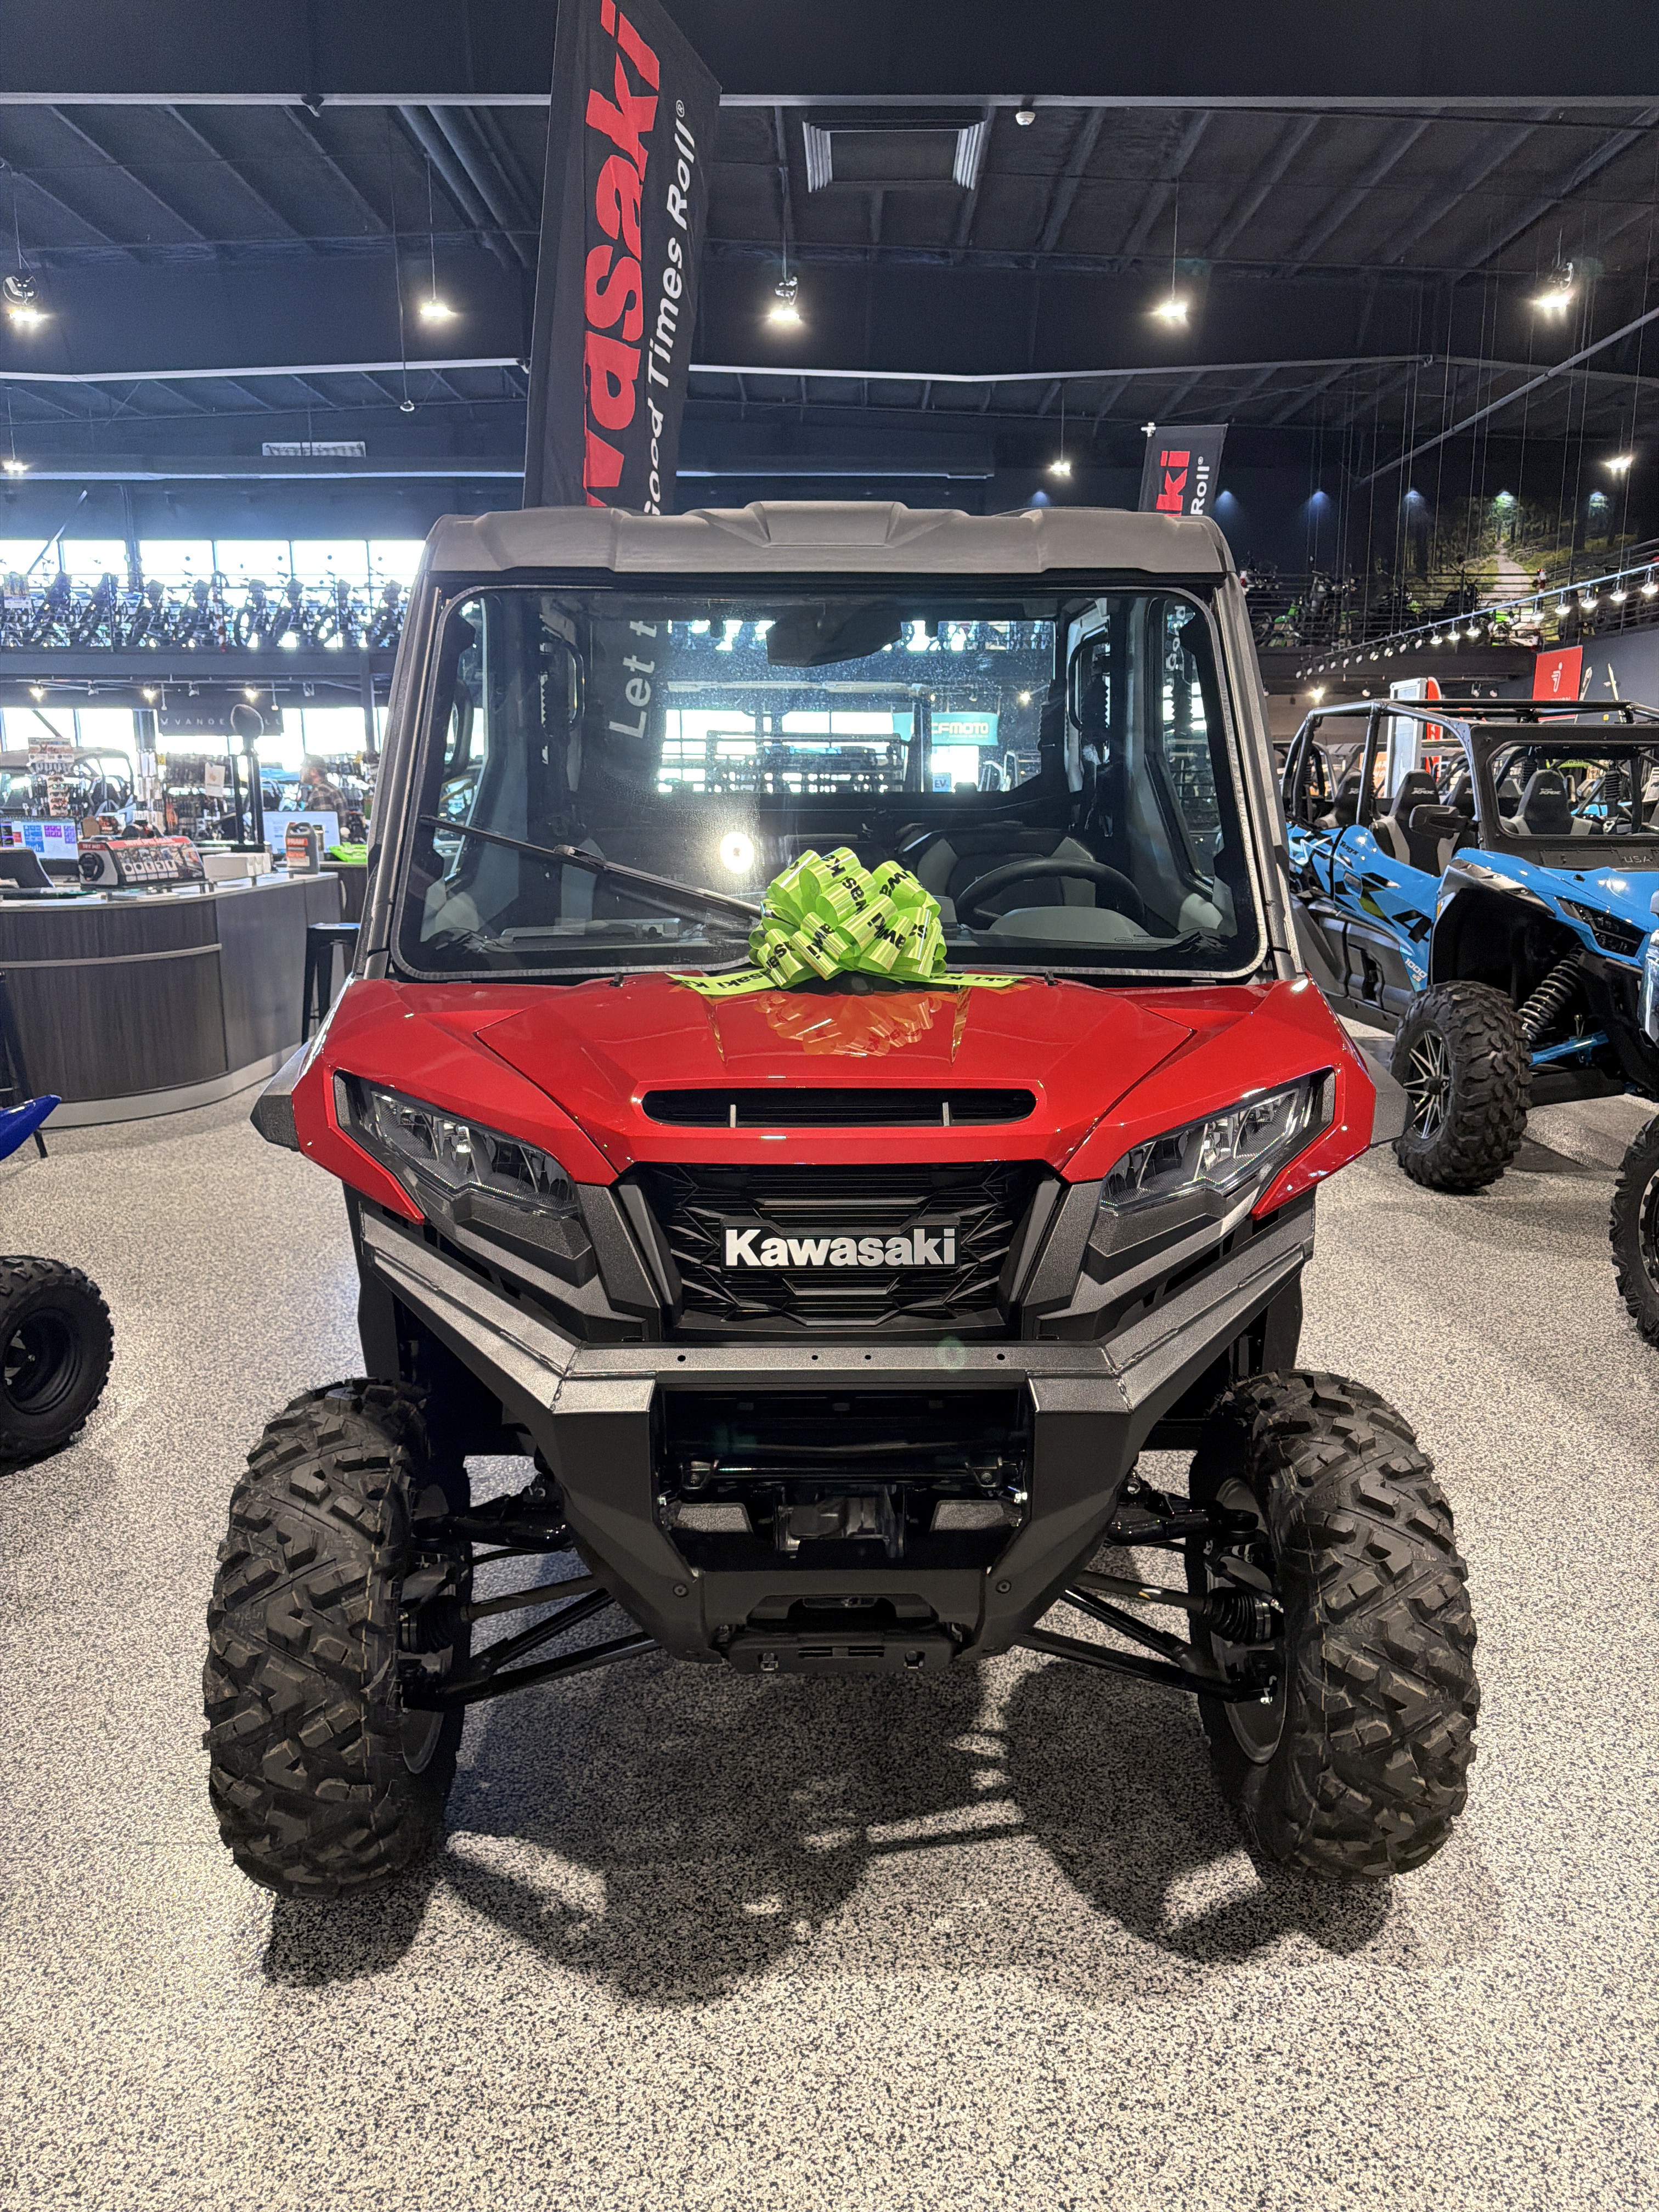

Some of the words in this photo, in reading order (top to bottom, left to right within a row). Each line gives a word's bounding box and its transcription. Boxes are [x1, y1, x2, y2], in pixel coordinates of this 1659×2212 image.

[609, 655, 655, 739] Let
[648, 238, 684, 388] Times
[1156, 450, 1190, 517] ki
[1404, 957, 1427, 979] 1000
[725, 1227, 956, 1267] Kawasaki
